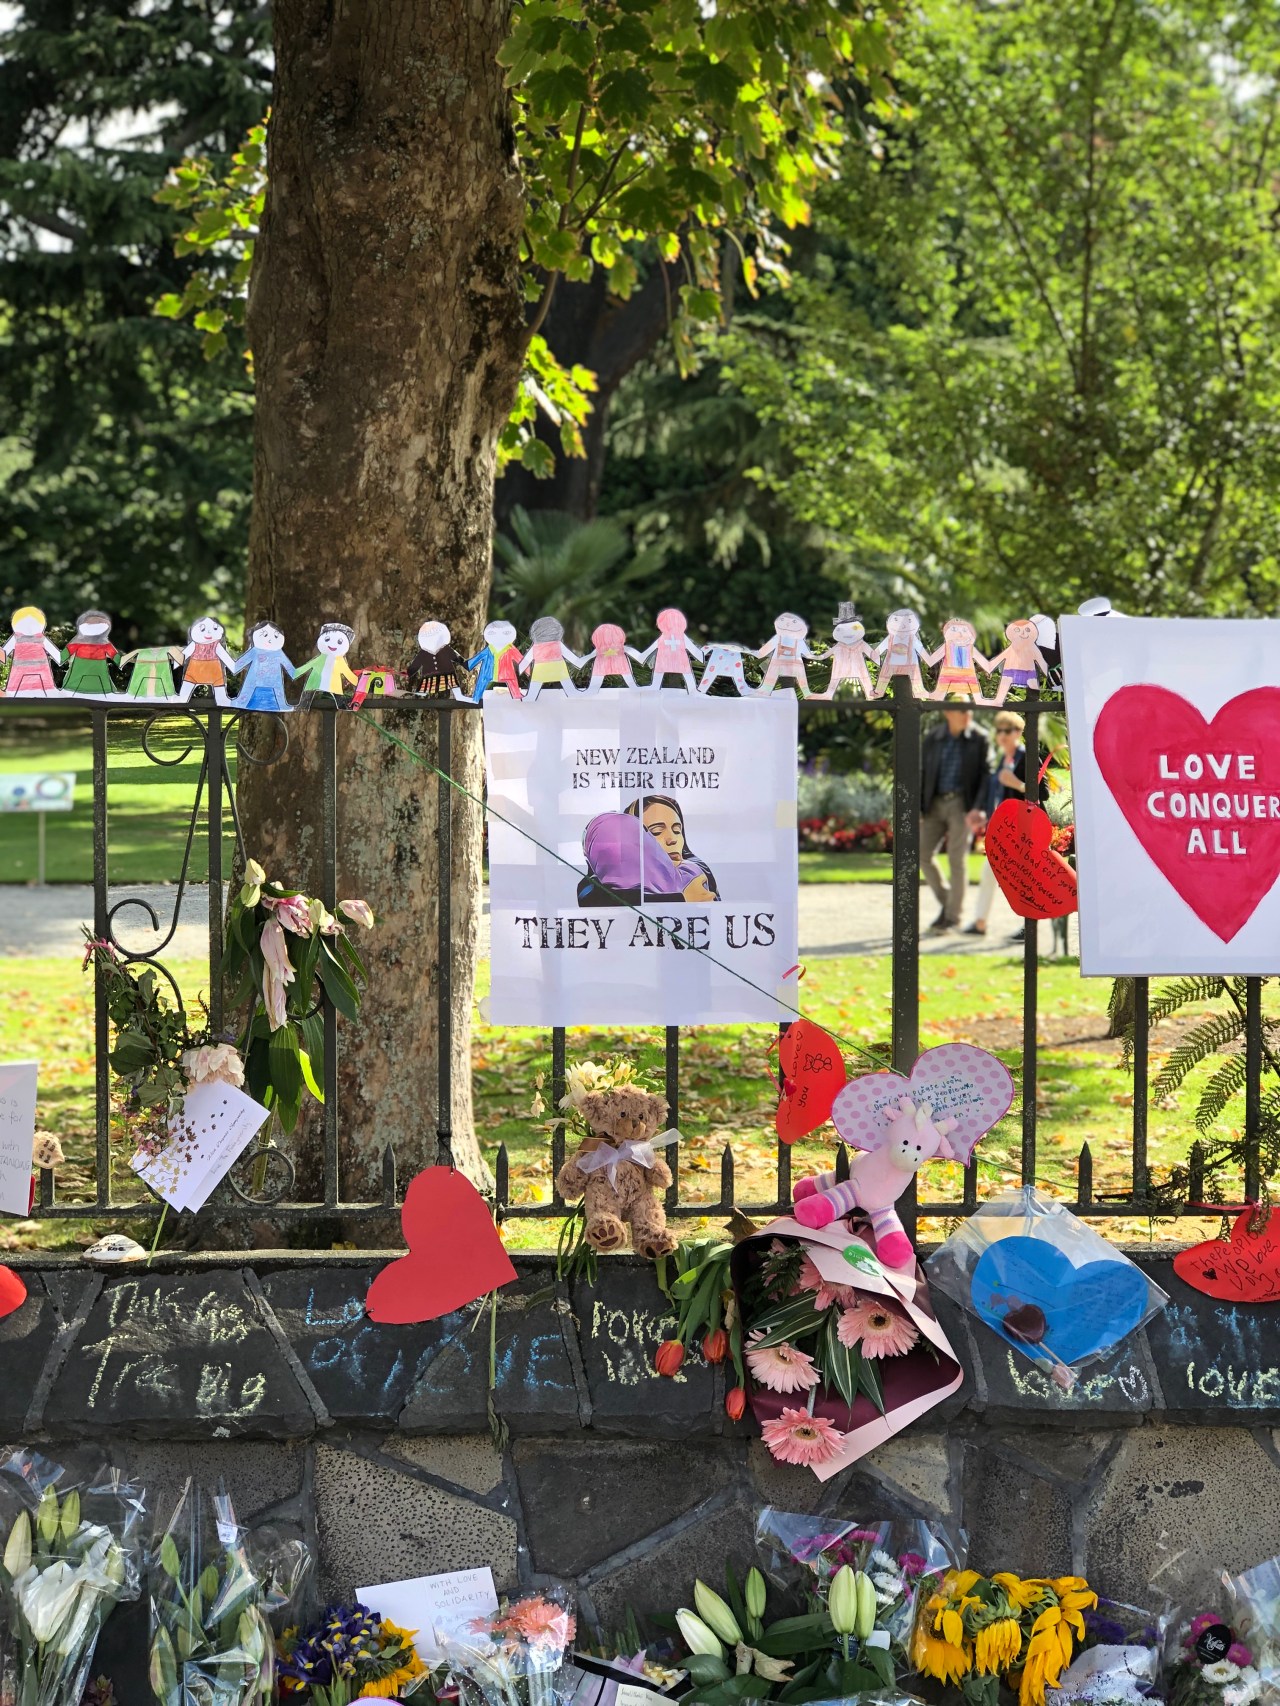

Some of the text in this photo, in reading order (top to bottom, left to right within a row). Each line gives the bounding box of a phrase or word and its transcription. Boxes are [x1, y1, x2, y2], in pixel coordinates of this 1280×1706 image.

[576, 747, 716, 766] NEW ZEALAND
[1159, 753, 1256, 780] LOVE
[572, 771, 720, 789] IS THEIR HOME
[1146, 791, 1280, 819] CONQUER
[1187, 828, 1247, 855] ALL
[515, 913, 776, 950] THEY ARE US
[429, 1573, 479, 1590] WITH LOVE
[443, 1586, 460, 1596] AND
